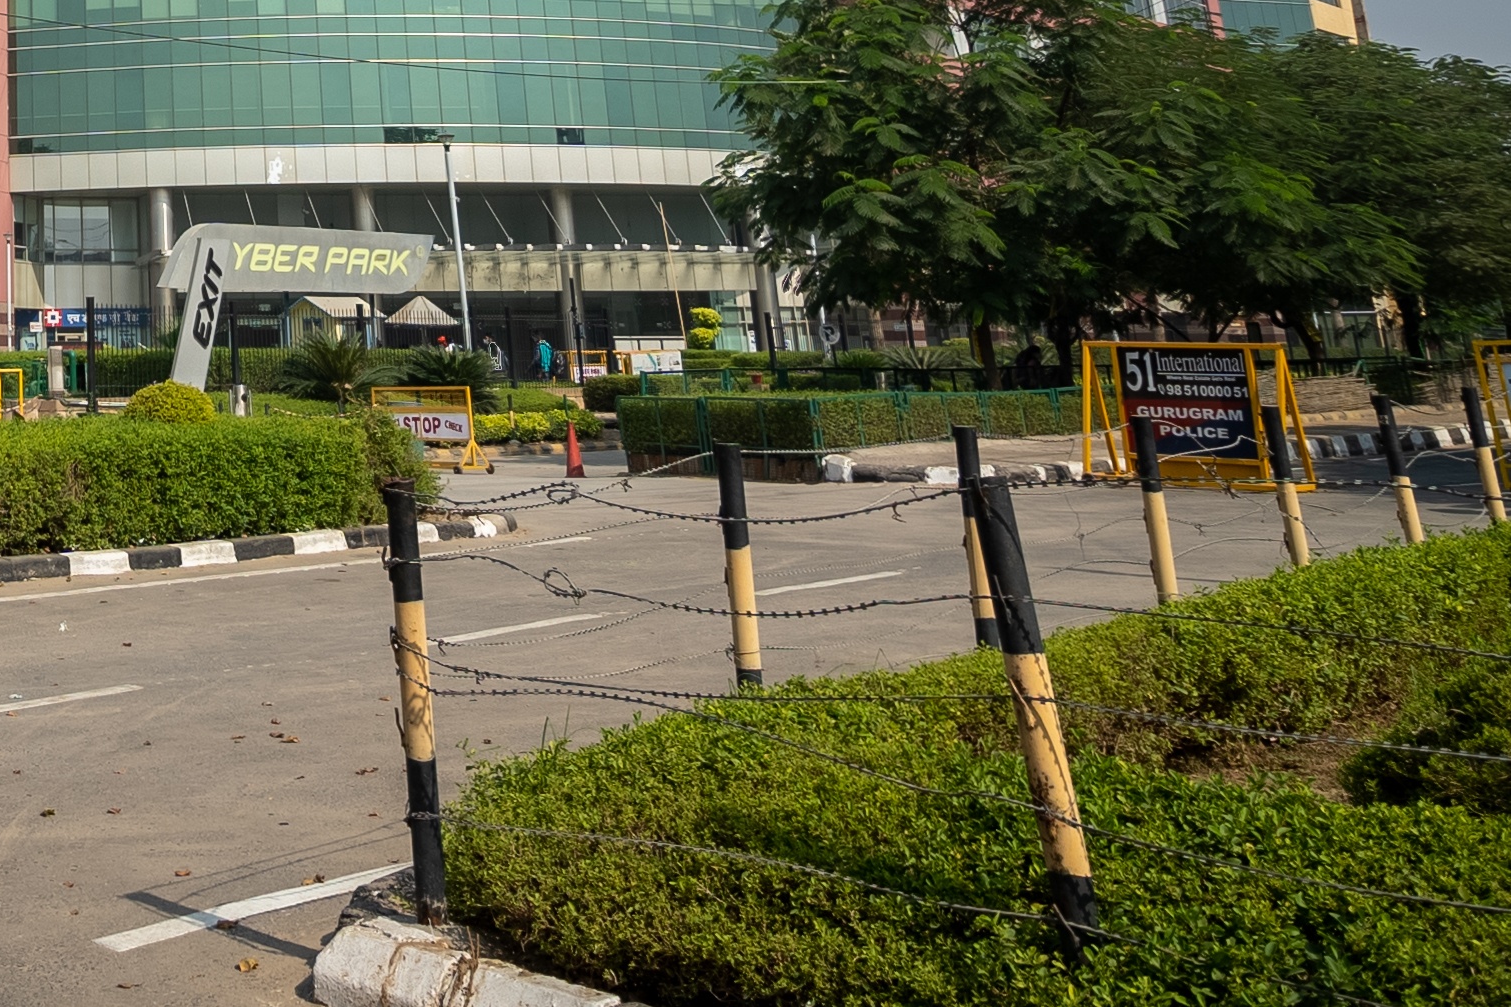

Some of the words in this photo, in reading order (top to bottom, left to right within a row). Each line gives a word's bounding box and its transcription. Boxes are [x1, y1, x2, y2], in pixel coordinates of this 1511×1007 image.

[232, 242, 320, 273] YBER
[324, 246, 411, 277] PARK
[193, 247, 223, 350] EXIT
[1125, 351, 1157, 392] 51
[1155, 351, 1245, 373] International
[1136, 405, 1244, 422] GURUGRAM
[403, 416, 441, 434] STOP
[444, 419, 463, 434] CHECK
[1159, 425, 1230, 439] POLICE
